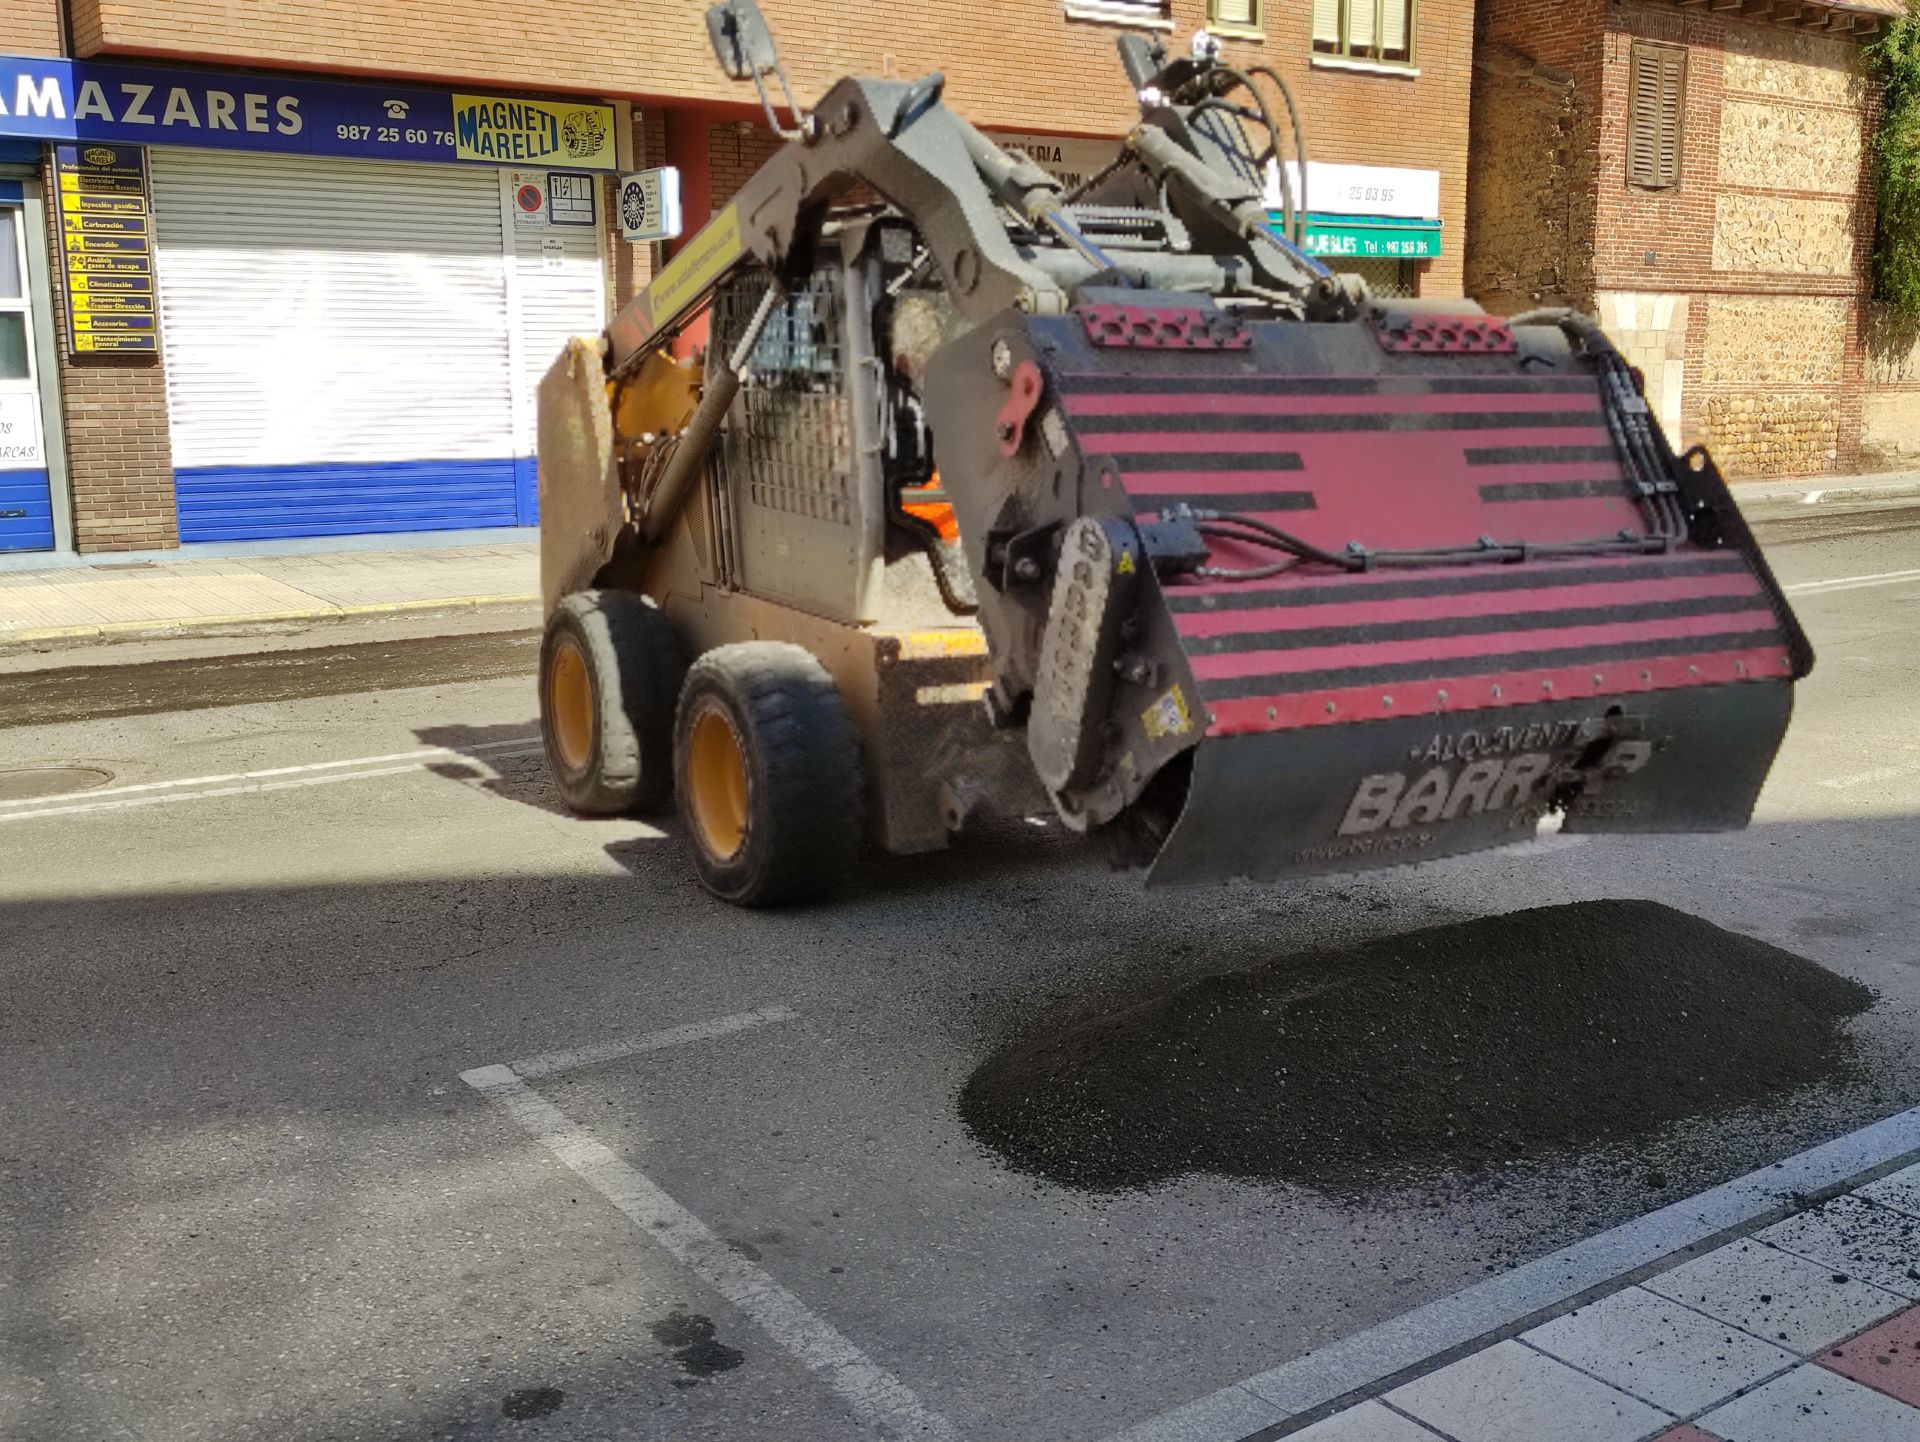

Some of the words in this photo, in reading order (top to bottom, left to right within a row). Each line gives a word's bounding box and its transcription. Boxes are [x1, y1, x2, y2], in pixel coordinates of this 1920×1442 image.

[0, 74, 303, 136] MAZARES
[457, 102, 558, 142] MAGNETI
[336, 124, 371, 141] 987
[377, 127, 400, 143] 25
[405, 129, 428, 144] 60
[432, 130, 456, 146] 76
[457, 118, 558, 160] MARELLI
[1348, 186, 1363, 200] 25
[82, 200, 112, 208] Inyección
[84, 221, 124, 229] Carburación
[89, 280, 132, 288] Climatización
[90, 296, 126, 304] Suspensión
